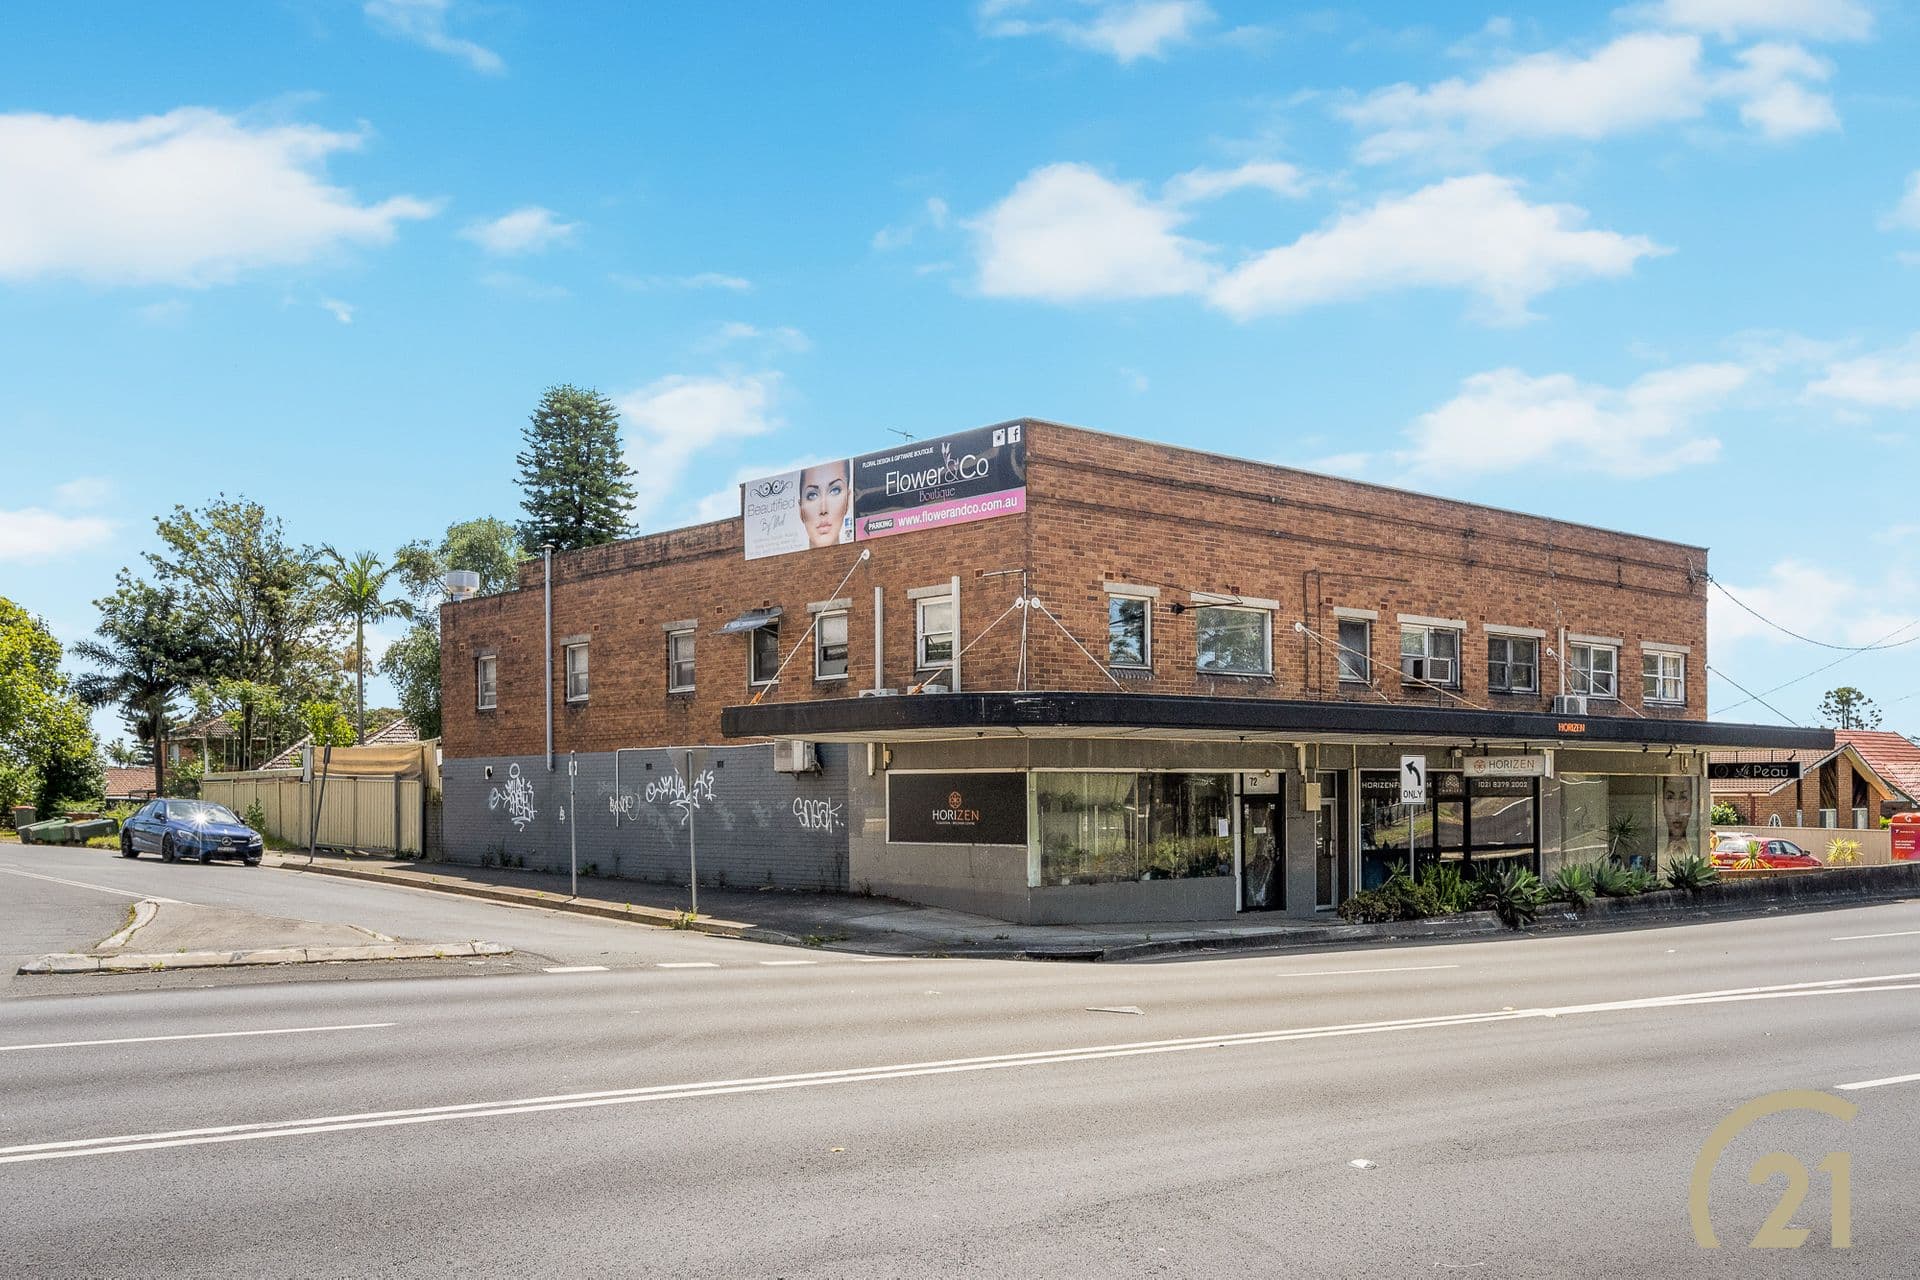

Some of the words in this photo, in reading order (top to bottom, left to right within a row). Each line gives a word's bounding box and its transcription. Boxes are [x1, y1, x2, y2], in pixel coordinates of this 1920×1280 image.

[914, 447, 934, 456] BOUTIQUE
[919, 486, 956, 502] Boutique
[747, 497, 796, 516] Beautified
[898, 496, 1018, 527] www.flowerandco.com.au
[868, 519, 893, 530] PARKING
[1558, 722, 1585, 732] HORIZEN
[1488, 759, 1535, 769] HORIZEN
[1753, 764, 1789, 777] Peau
[1249, 777, 1258, 787] 72
[1403, 790, 1423, 799] ONLY
[932, 809, 980, 821] HORIZEN
